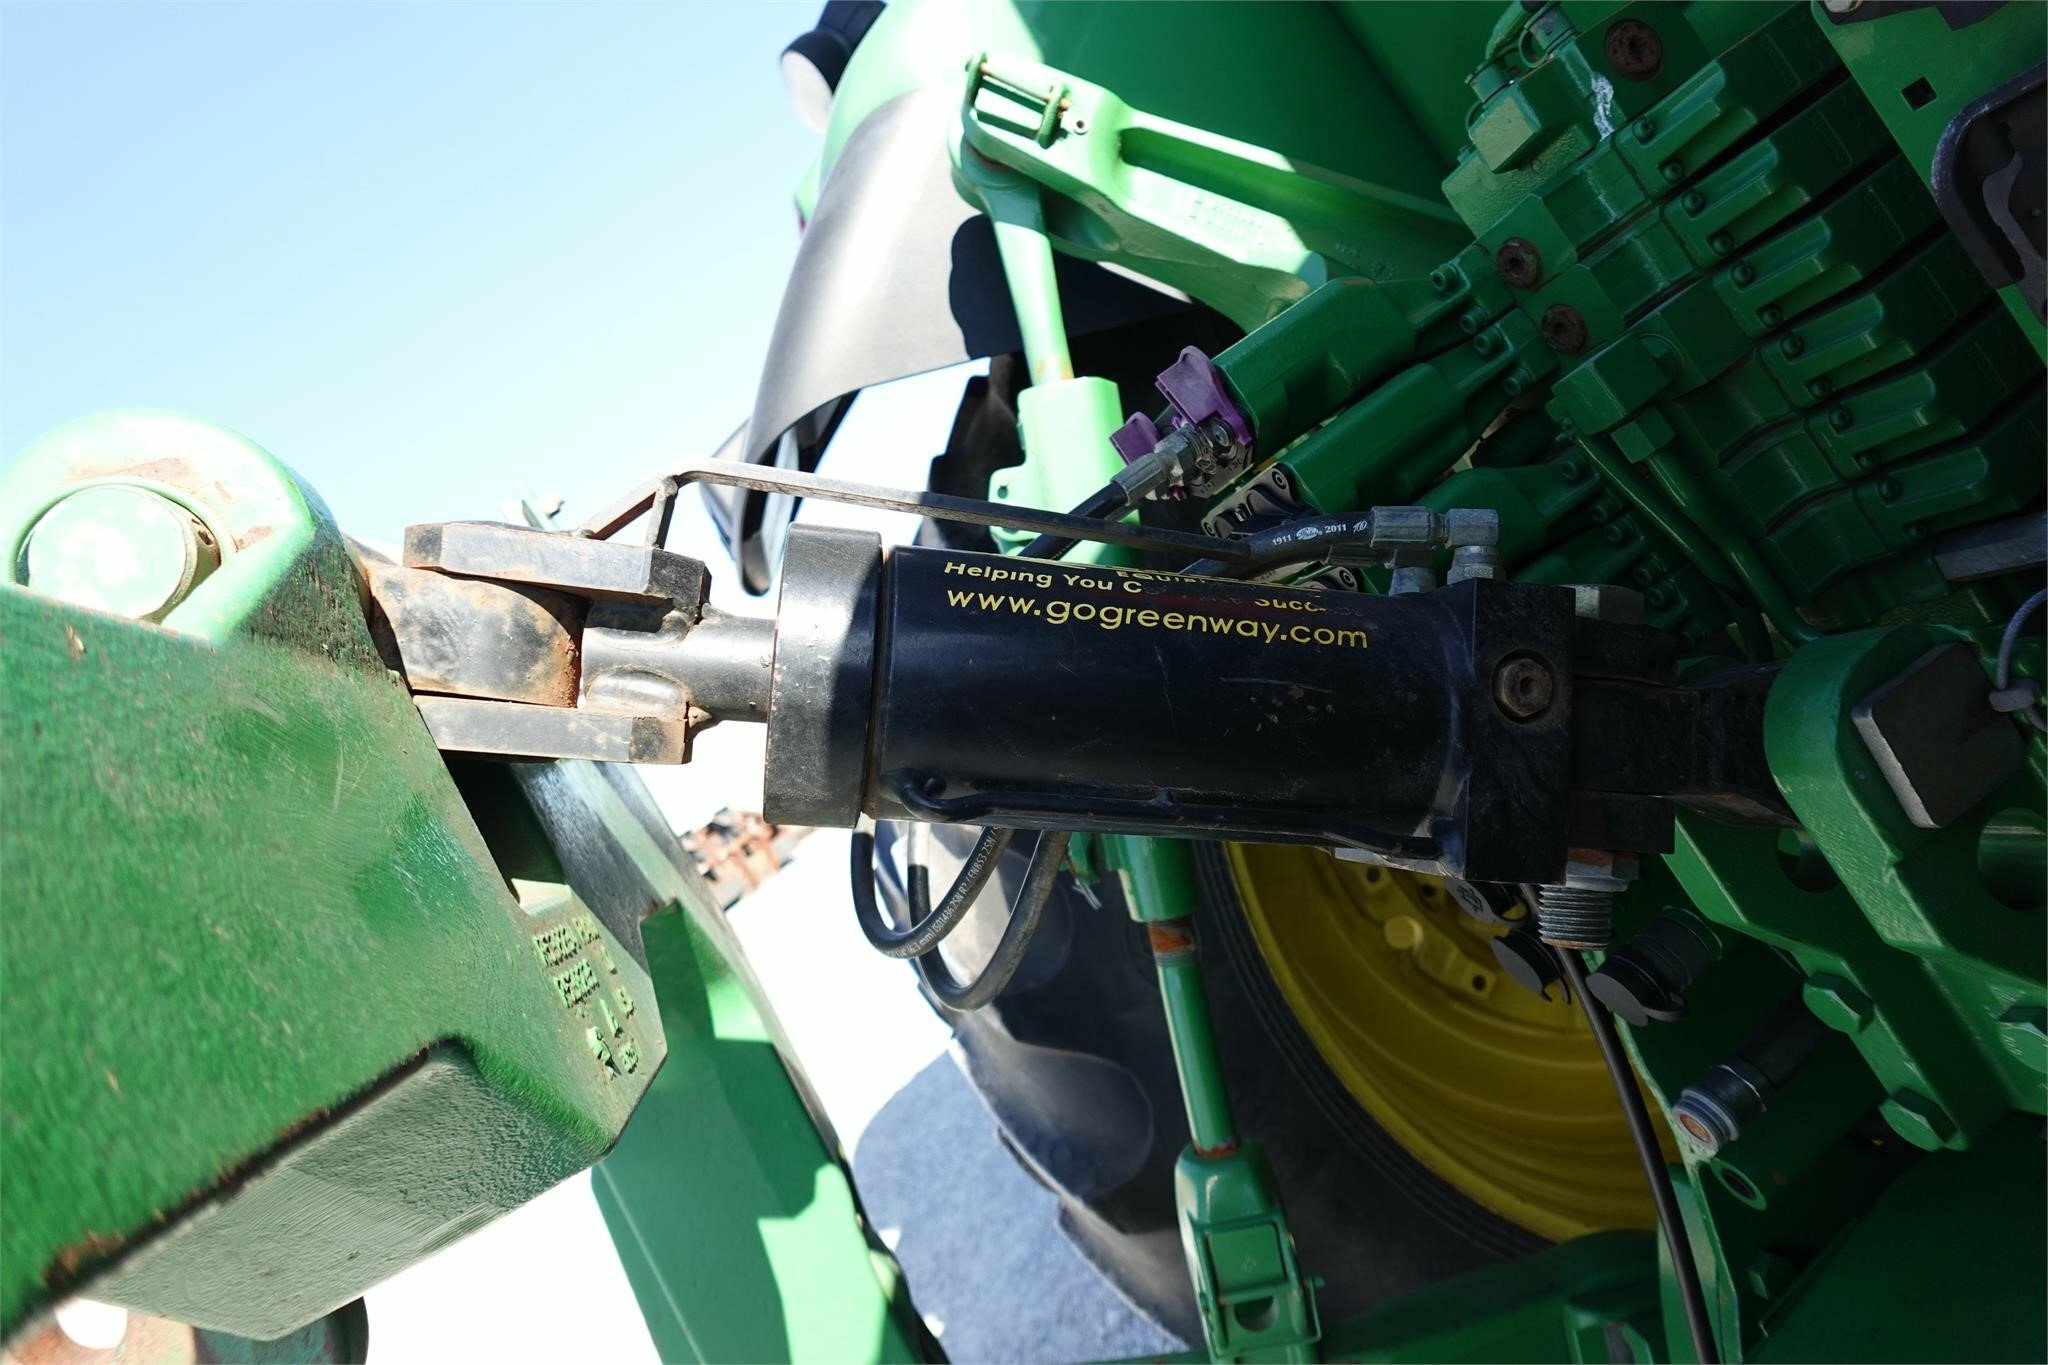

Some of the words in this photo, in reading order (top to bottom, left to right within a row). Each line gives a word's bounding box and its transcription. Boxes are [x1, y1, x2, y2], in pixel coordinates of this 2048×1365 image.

[1272, 534, 1293, 546] 1911
[1324, 523, 1348, 534] 2011
[944, 561, 1053, 588] Helping
[1063, 574, 1113, 591] You
[946, 589, 1369, 649] www.gogreenway.com
